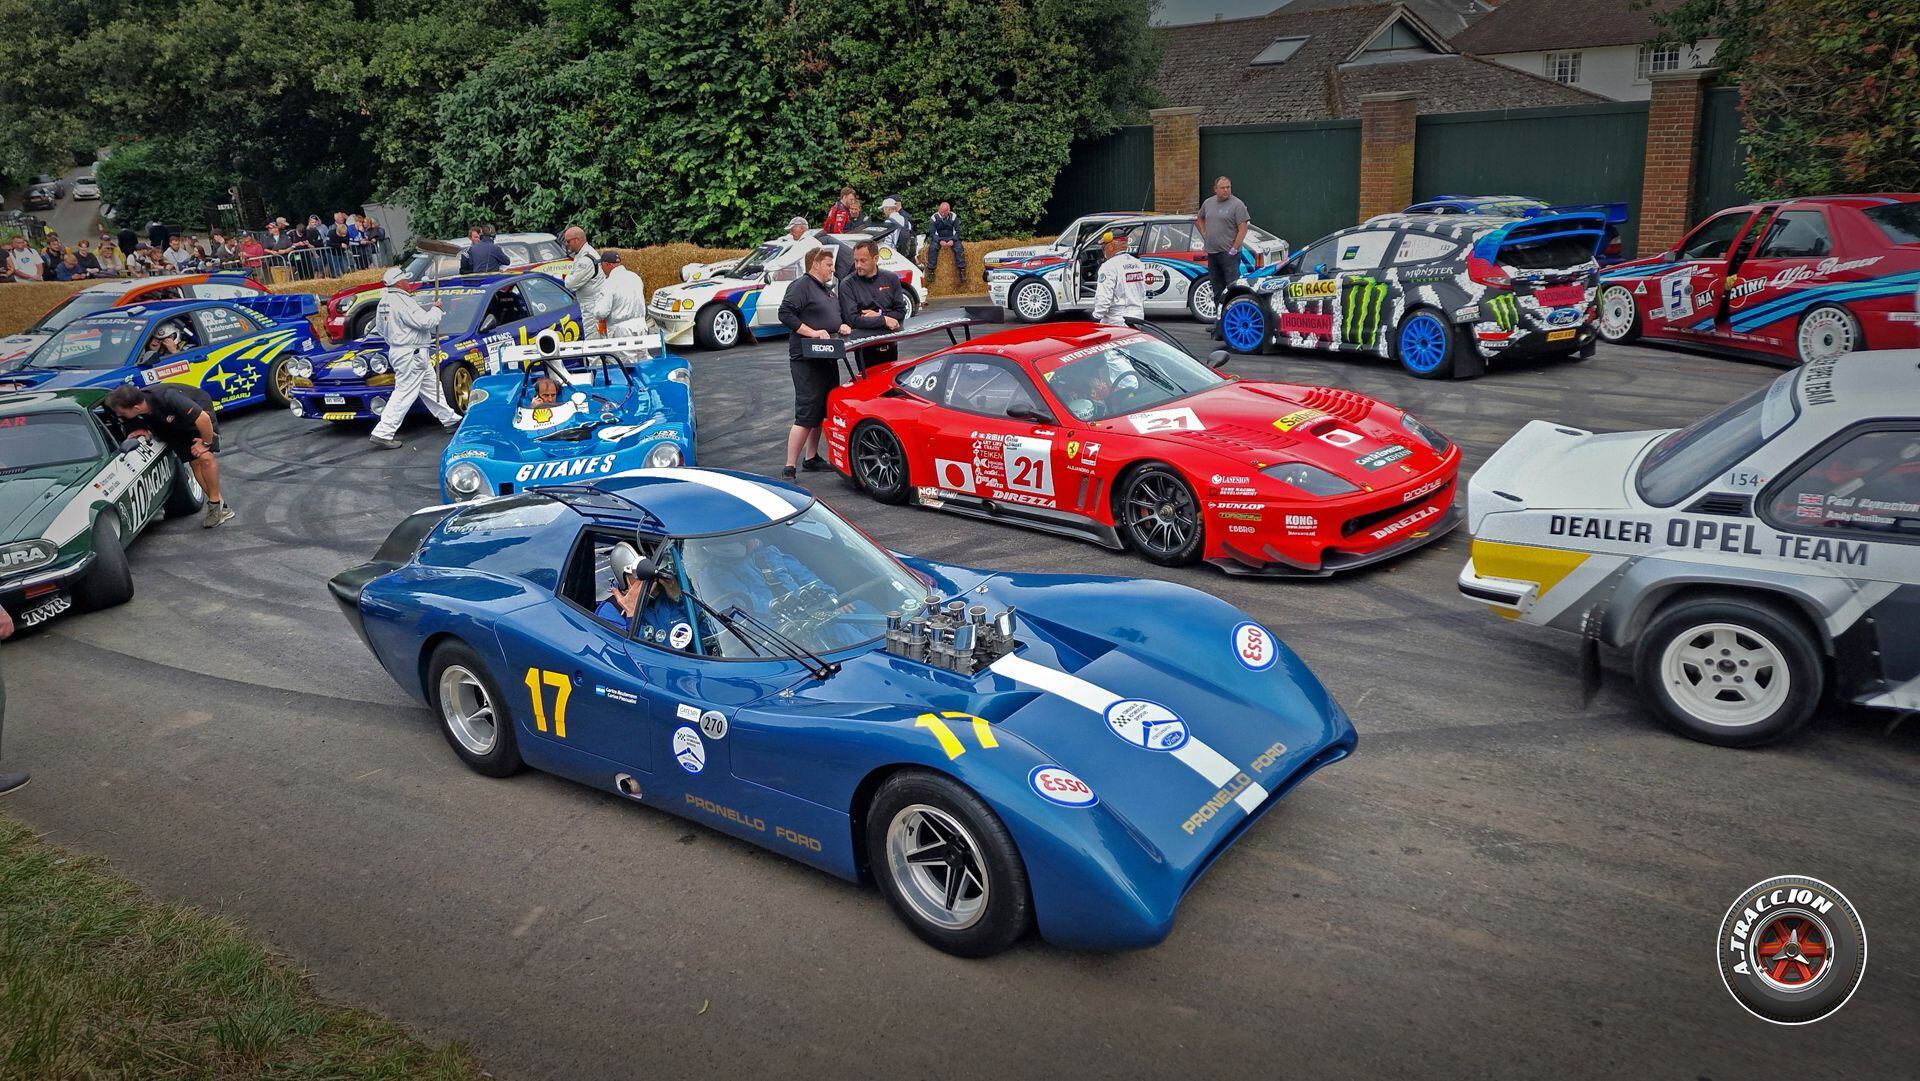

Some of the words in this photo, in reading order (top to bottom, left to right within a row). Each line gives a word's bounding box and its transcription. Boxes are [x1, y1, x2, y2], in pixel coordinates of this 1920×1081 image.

[1770, 264, 1815, 290] Alfa
[1815, 256, 1885, 275] Romeo
[1265, 280, 1286, 290] Ford
[1290, 283, 1303, 297] 15
[1305, 281, 1335, 294] RACC
[1671, 280, 1682, 309] 5
[1285, 316, 1329, 330] HOONIGAN
[1554, 312, 1576, 323] Ford
[811, 344, 835, 352] RECARO
[146, 371, 154, 381] 8
[221, 392, 251, 403] SUBARU
[1147, 416, 1188, 430] 21
[980, 450, 1004, 460] TEIKEN
[515, 454, 617, 482] GITANES
[1013, 456, 1044, 489] 21
[1730, 472, 1760, 487] 154
[919, 487, 938, 496] NGK
[993, 489, 1057, 509] DIREZZA
[1404, 478, 1442, 502] prodrive
[1217, 502, 1266, 511] DUNLOP
[1369, 506, 1441, 540] DIREZZA
[1550, 515, 1652, 544] DEALER
[1666, 518, 1762, 556] OPEL
[1776, 534, 1869, 566] TEAM
[21, 596, 71, 627] TWR
[525, 667, 573, 738] 17
[704, 716, 723, 734] 270
[914, 710, 1000, 761] 17
[1181, 772, 1252, 836] PRONELLO
[1249, 742, 1288, 773] FORD
[684, 792, 766, 832] PRONELLO
[775, 825, 822, 852] FORD
